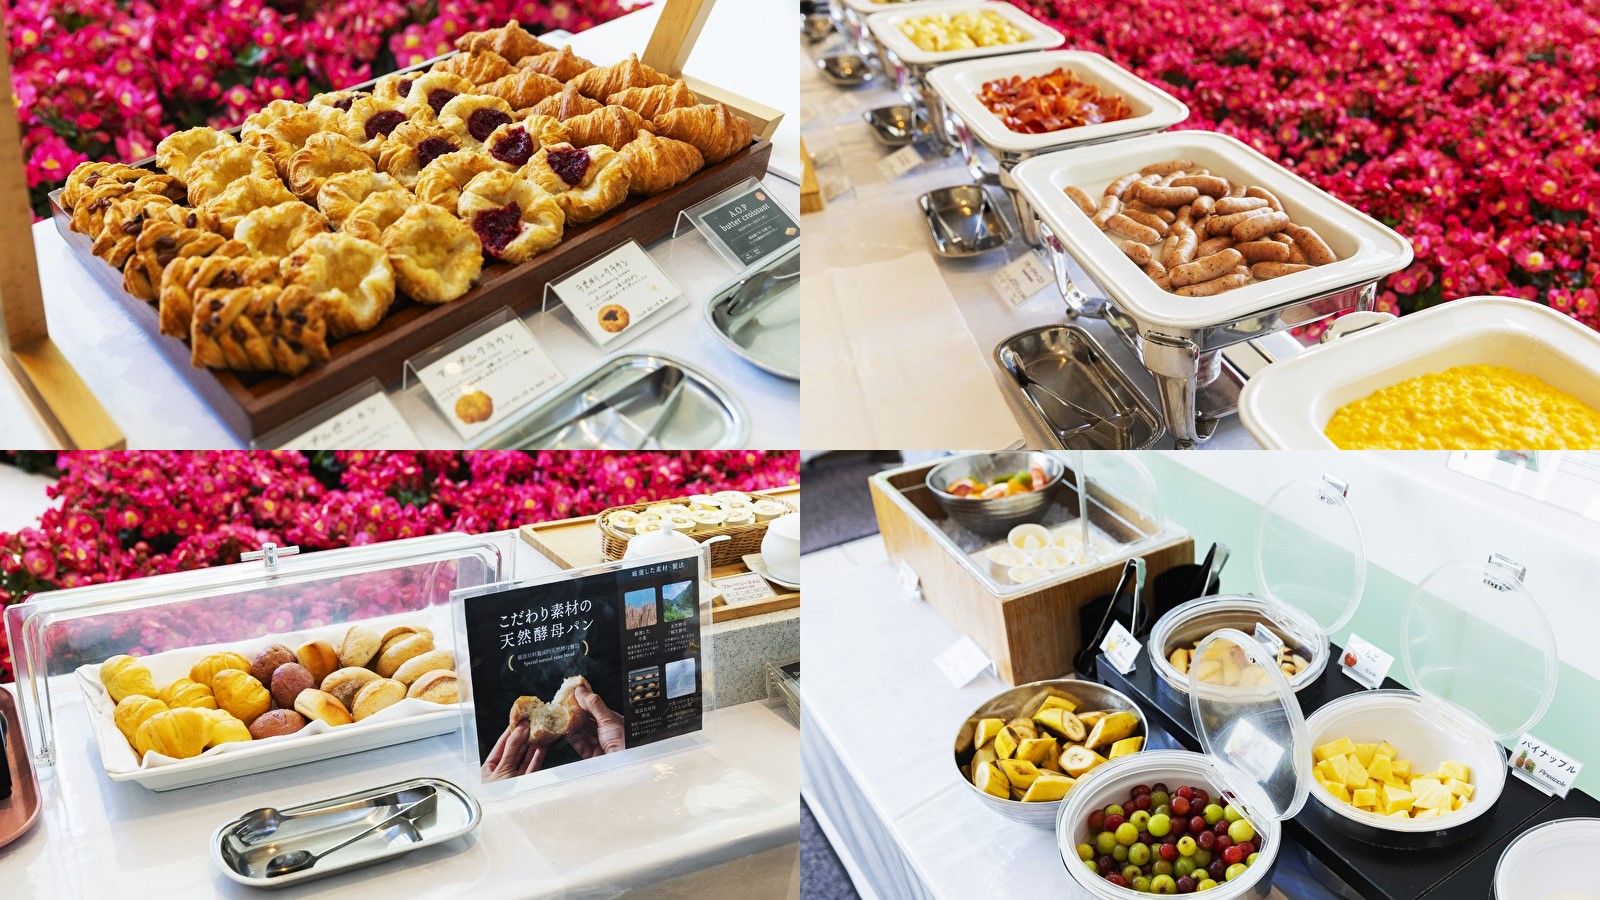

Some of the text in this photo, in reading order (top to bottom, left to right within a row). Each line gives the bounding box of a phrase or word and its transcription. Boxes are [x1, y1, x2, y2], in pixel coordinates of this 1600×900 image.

[719, 203, 770, 232] butter croissant
[437, 332, 514, 379] アプルクラウン
[500, 600, 592, 628] こだわり素材の
[500, 619, 593, 650] 天然酵母パン
[1522, 740, 1576, 774] パイナップル
[1539, 769, 1567, 788] Pineapple
